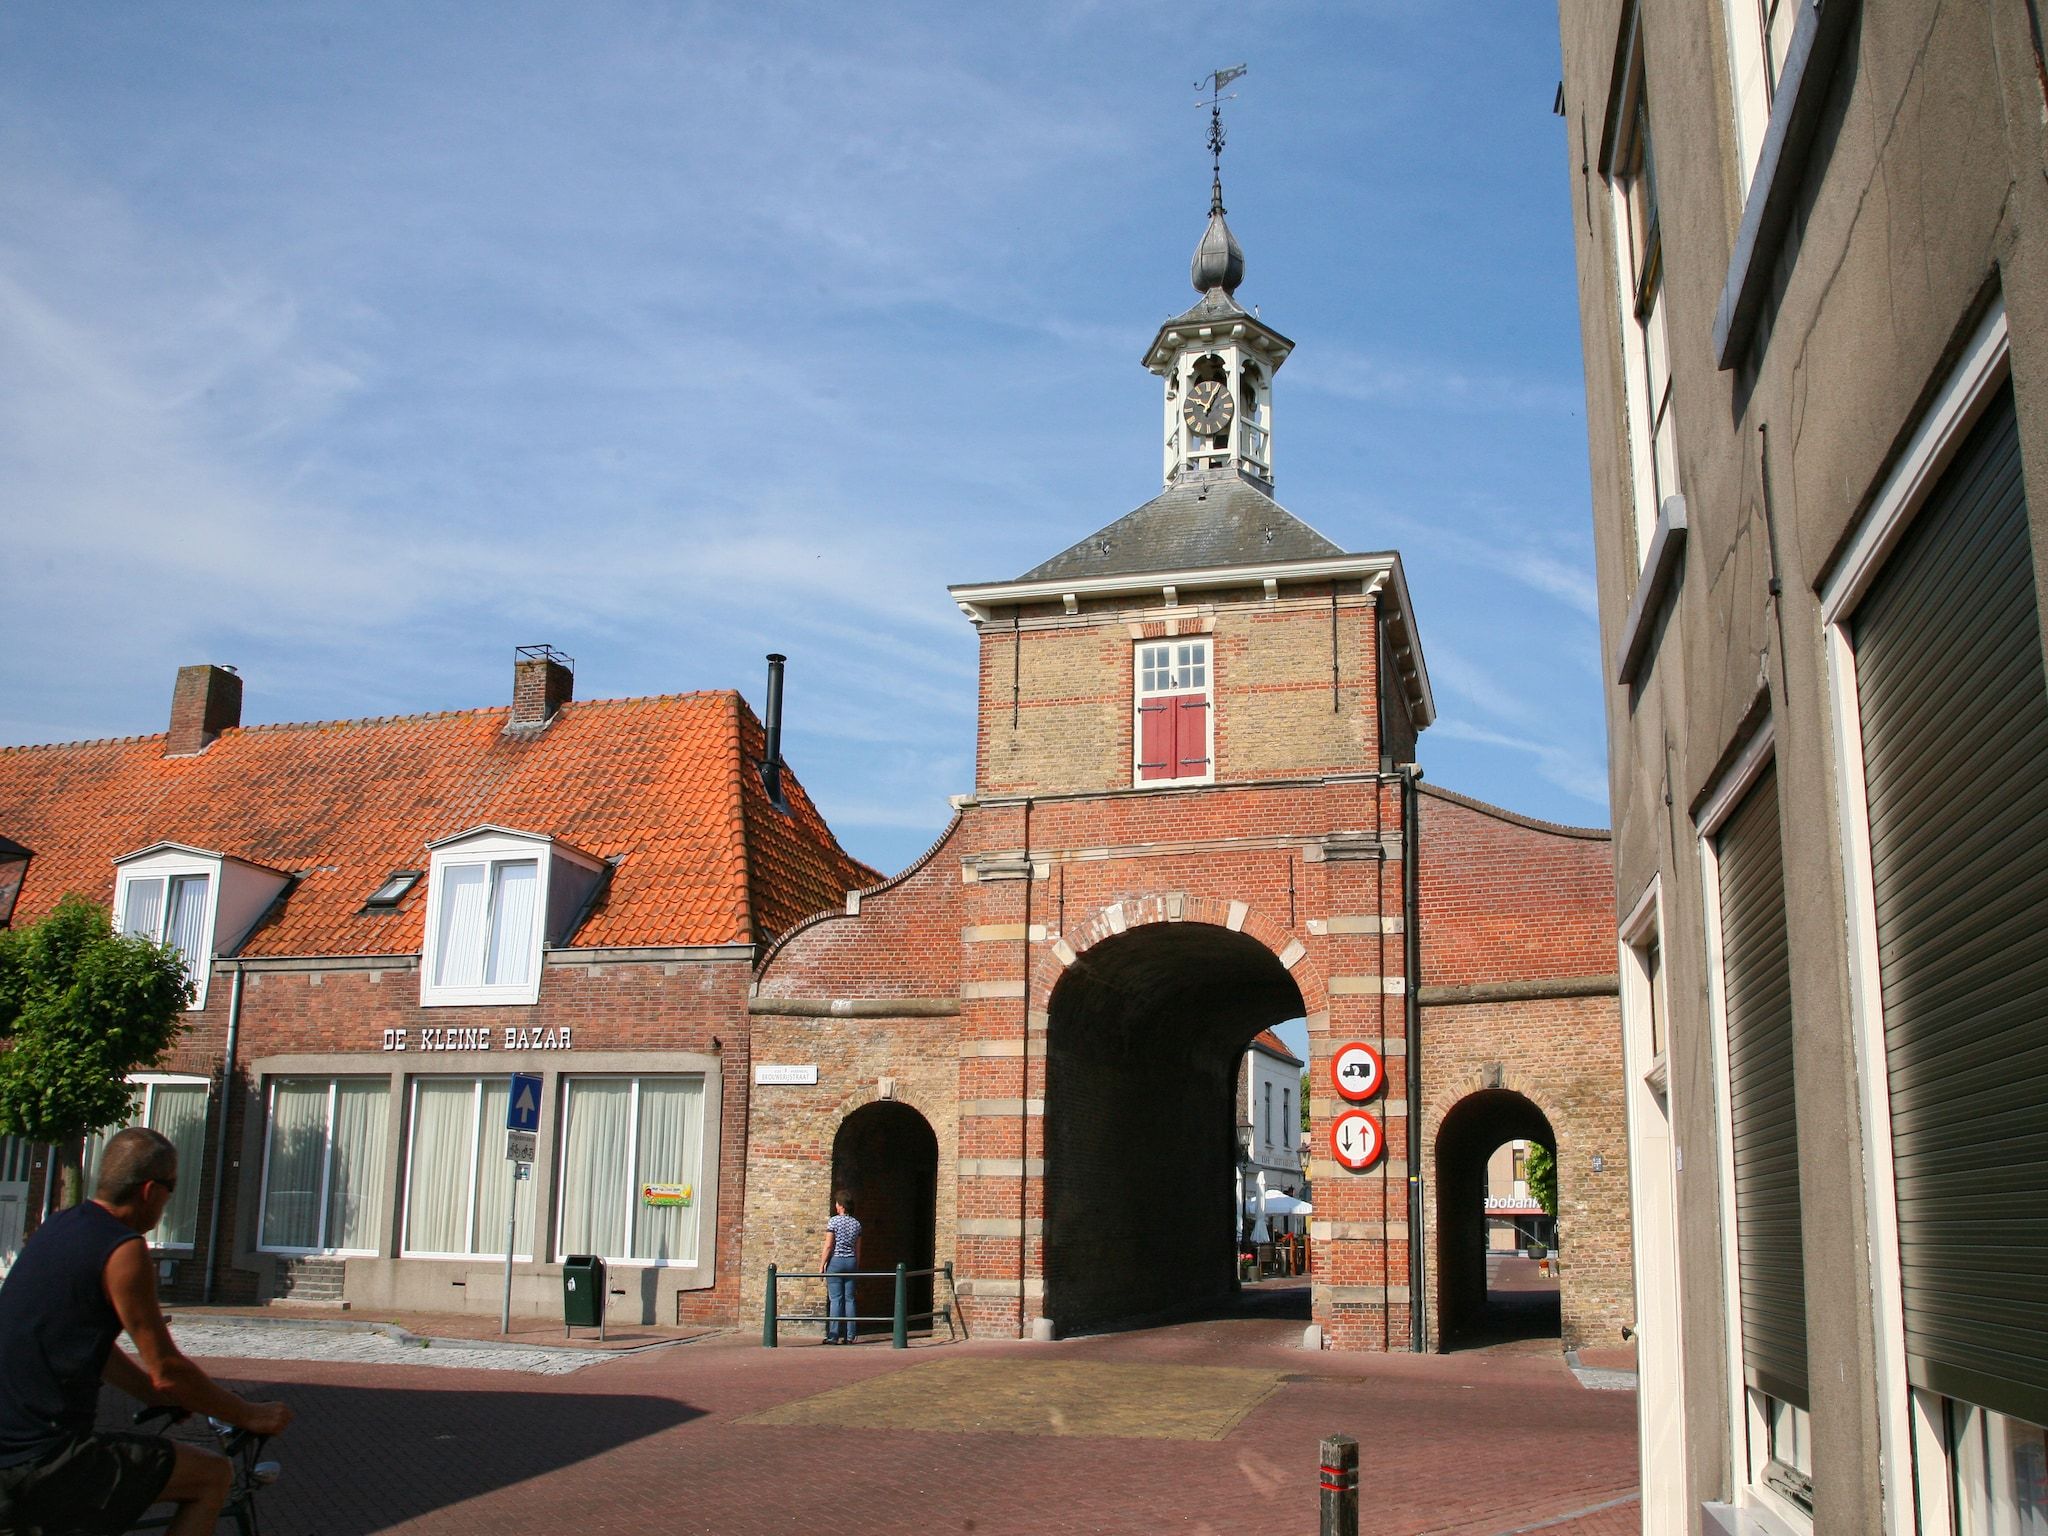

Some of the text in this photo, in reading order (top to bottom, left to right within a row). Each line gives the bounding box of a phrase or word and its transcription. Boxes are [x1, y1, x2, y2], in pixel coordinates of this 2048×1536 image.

[383, 1027, 572, 1050] DE KLEINE BAZAR
[1484, 1194, 1542, 1209] abobank
